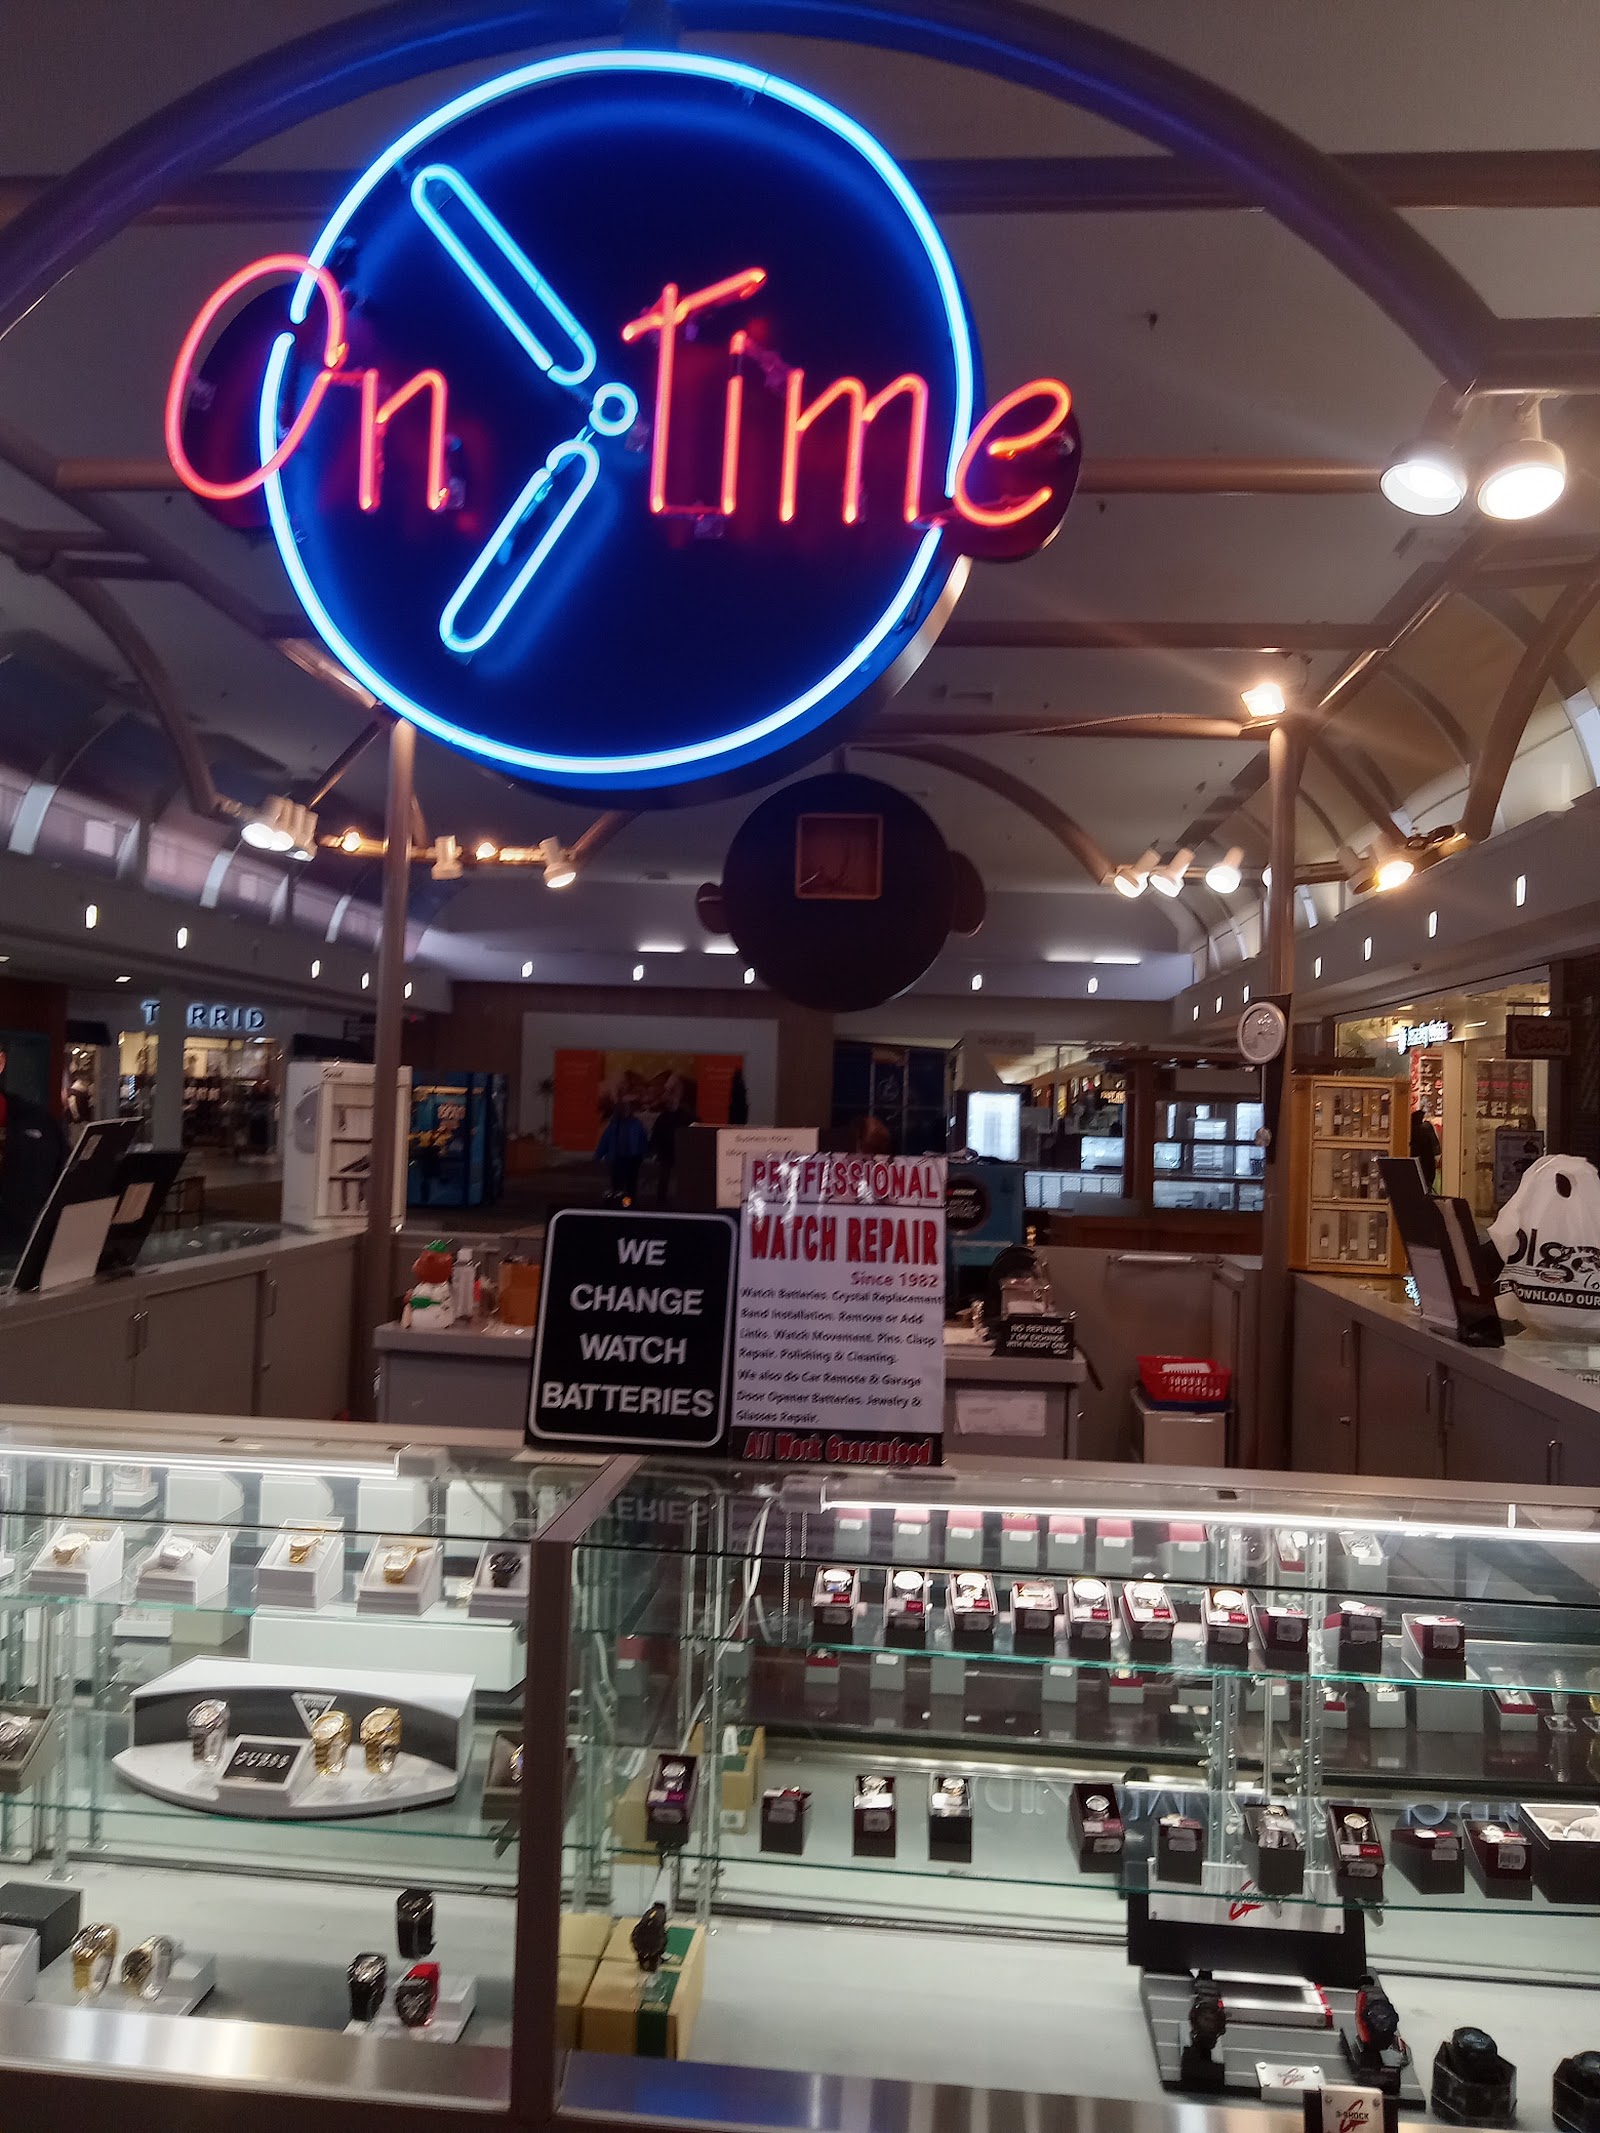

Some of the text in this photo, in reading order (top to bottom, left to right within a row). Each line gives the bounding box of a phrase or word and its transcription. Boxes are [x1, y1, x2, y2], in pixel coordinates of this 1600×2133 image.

[163, 253, 1073, 526] On Time
[140, 999, 266, 1032] TRRID
[751, 1213, 939, 1266] WATCH REPAIR
[616, 1236, 669, 1266] WE
[850, 1271, 939, 1288] Since 1982
[569, 1282, 705, 1316] CHANGE
[740, 1287, 774, 1298] Watch
[831, 1290, 869, 1304] Crystal
[1516, 1285, 1574, 1304] OWNLOAD
[740, 1307, 769, 1320] Band
[838, 1310, 882, 1323] Remove
[884, 1313, 898, 1323] or
[899, 1313, 924, 1325] Add
[773, 1329, 809, 1341] Watch
[905, 1333, 936, 1347] Clasp
[1010, 1323, 1065, 1334] NO REFUNDS
[578, 1332, 689, 1365] WATCH
[779, 1349, 831, 1364] Polishing
[833, 1351, 845, 1362] &
[737, 1369, 922, 1388] We also do Car Remote & Garage
[540, 1380, 716, 1418] BATTERIES
[736, 1390, 765, 1402] Door
[767, 1391, 810, 1405] Opener
[866, 1394, 909, 1409] Jewelry
[911, 1396, 922, 1407] &
[736, 1410, 777, 1422] Glasses
[742, 1431, 934, 1466] All Work Guaranteed
